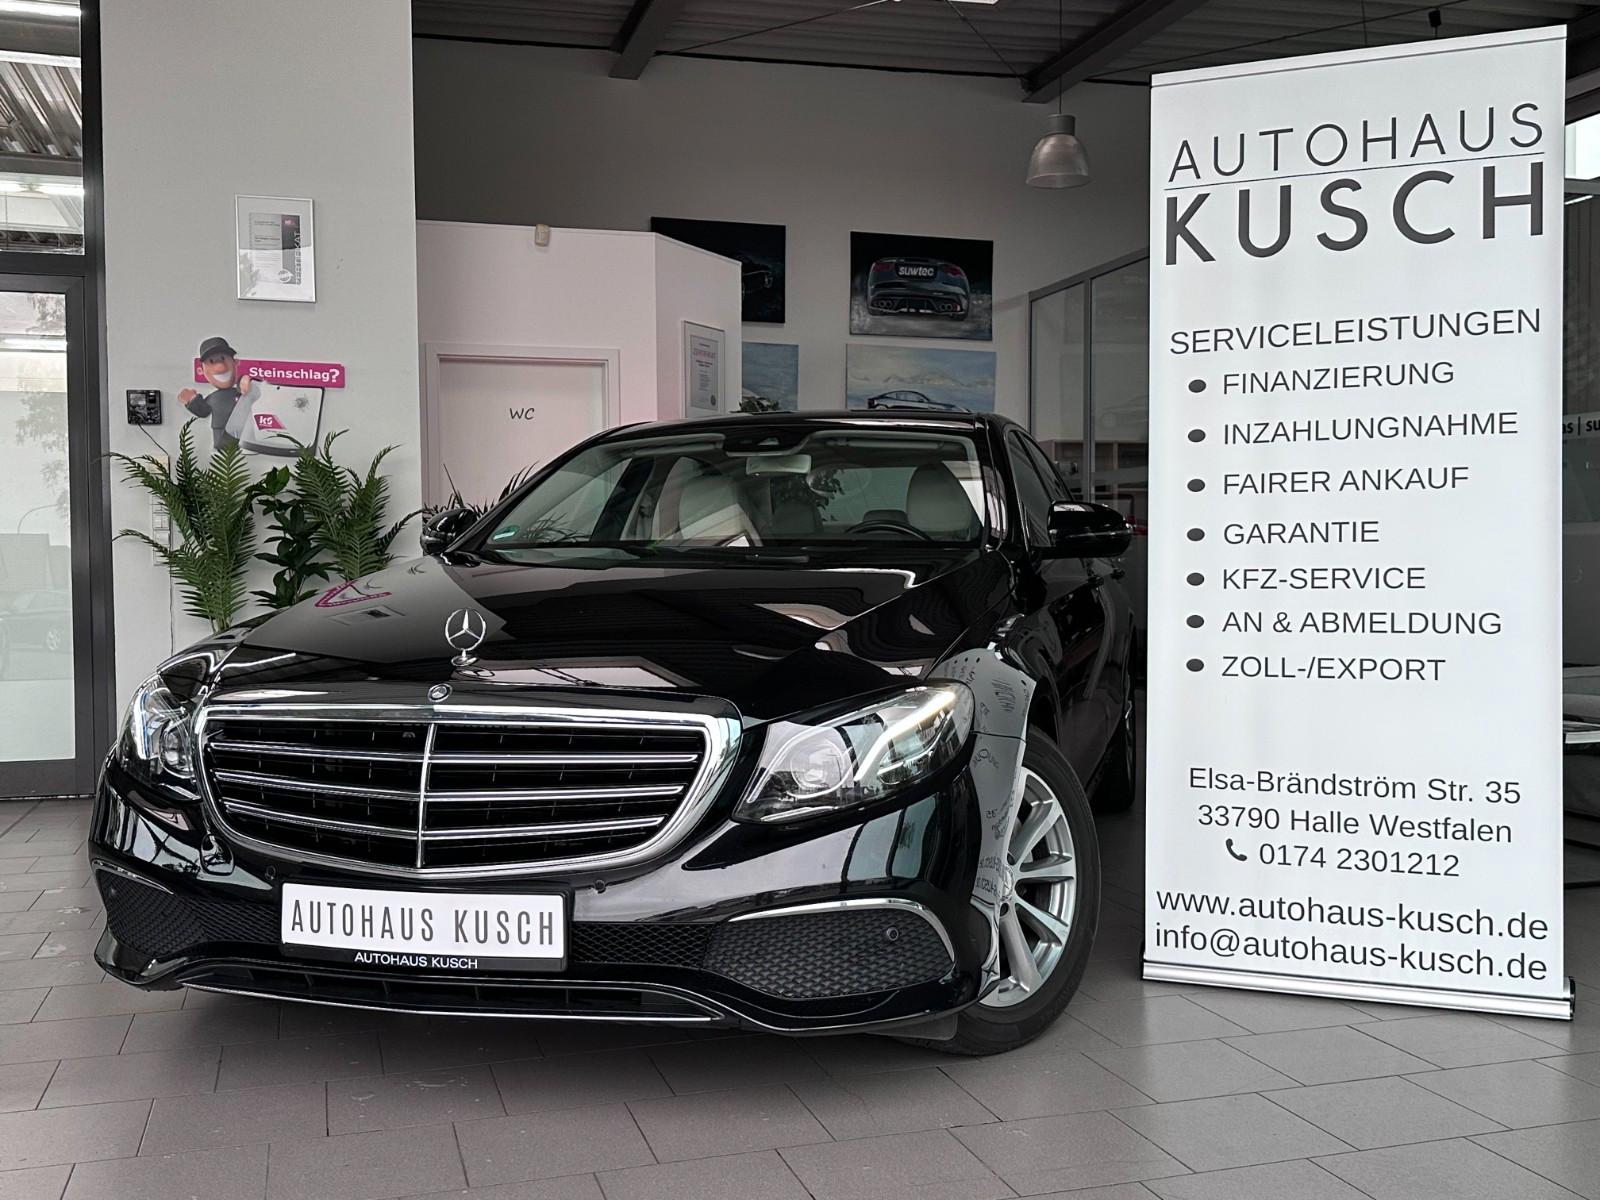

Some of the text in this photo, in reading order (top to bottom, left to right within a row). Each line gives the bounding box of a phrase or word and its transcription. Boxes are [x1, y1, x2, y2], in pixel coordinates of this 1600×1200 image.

[1168, 102, 1544, 183] AUTOHAUS
[1165, 161, 1545, 266] KUSCH
[1169, 307, 1541, 356] SERVICELEISTUNGEN
[249, 366, 340, 383] Steinschlag?
[1222, 360, 1454, 395] FINANZIERUNG
[509, 407, 535, 420] WC
[1223, 410, 1519, 445] INZAHLUNGNAHME
[1223, 466, 1470, 496] FAIRER ANKAUF
[1222, 520, 1381, 546] GARANTIE
[1222, 566, 1427, 591] KFZ-SERVICE
[1221, 611, 1502, 636] AN & ABMELDUNG
[1220, 655, 1447, 682] ZOLL-/EXPORT
[1189, 766, 1522, 805] Elsa-Brändström Str. 35
[1197, 803, 1513, 844] 33790 Halle Westfalen
[1258, 842, 1460, 878] 0174 2301212
[290, 898, 554, 946] AUTOHAUS KUSCH
[1156, 890, 1549, 941] www.autohaus-kusch.de
[354, 951, 478, 970] AUTOHAUS KUSCH
[1154, 921, 1548, 982] info@autohaus-kusch.de
